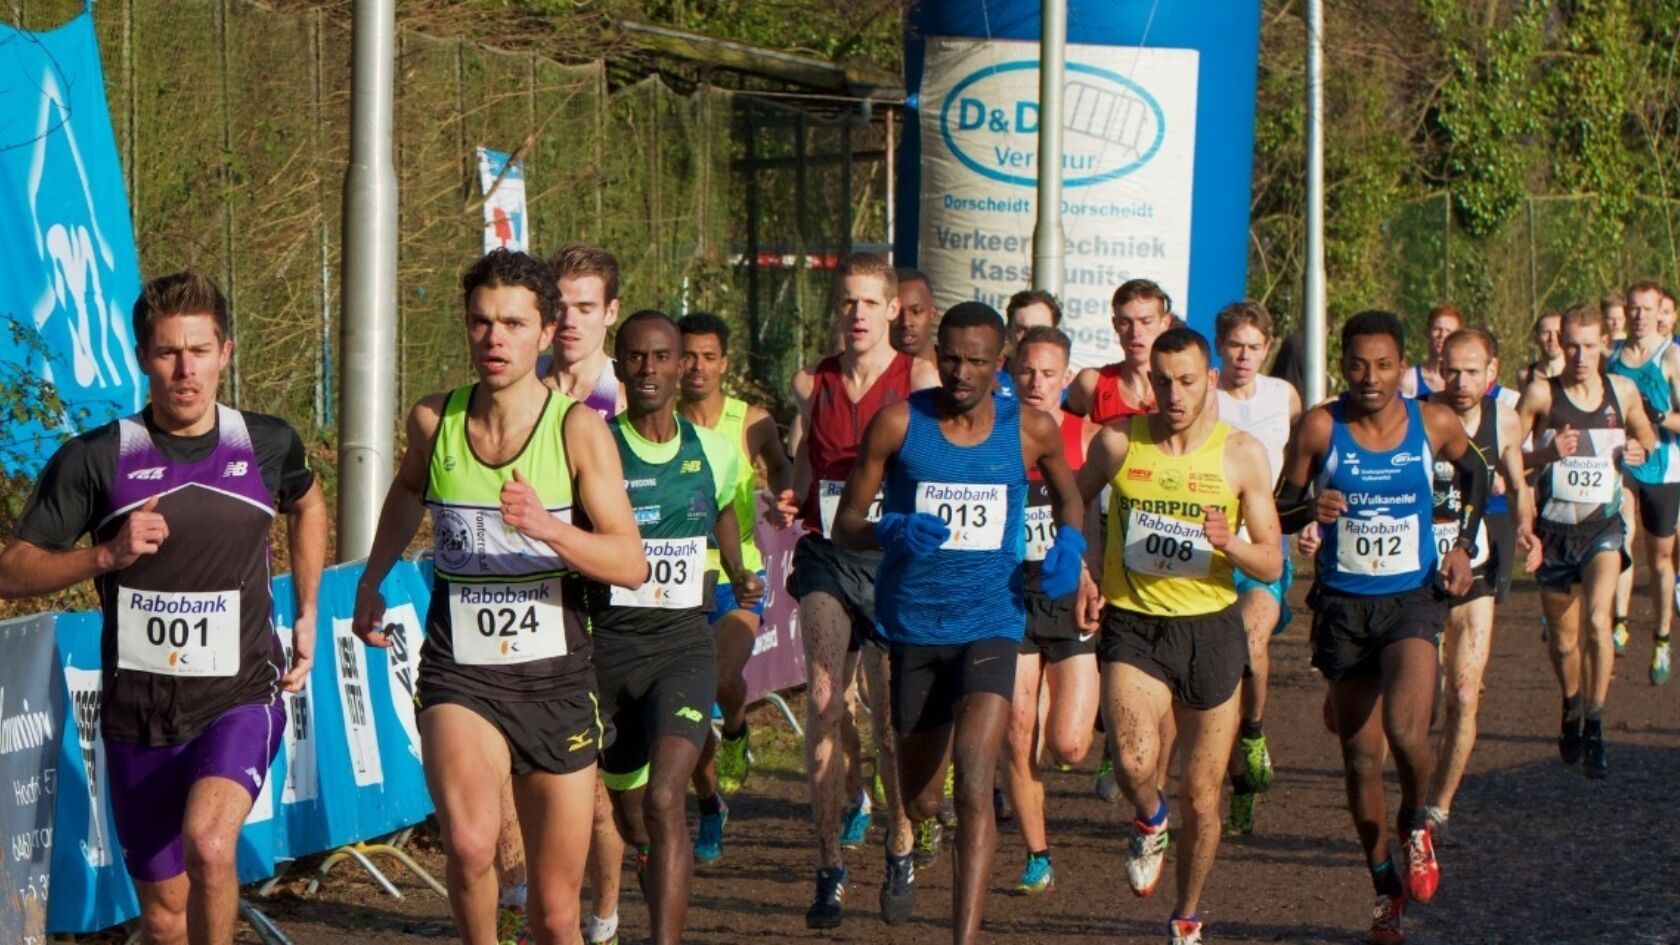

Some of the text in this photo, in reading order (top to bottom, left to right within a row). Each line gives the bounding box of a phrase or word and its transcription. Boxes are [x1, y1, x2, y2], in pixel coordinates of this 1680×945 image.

[944, 194, 1030, 213] Dorscheidt
[1568, 470, 1602, 487] 032
[925, 485, 998, 501] Rabobank
[937, 503, 987, 528] 013
[1346, 520, 1410, 535] Rabobank
[645, 540, 697, 556] bobank
[1146, 533, 1193, 562] 008
[1356, 536, 1401, 557] 012
[130, 593, 226, 613] Rabobank
[460, 584, 549, 604] Rabobank
[477, 606, 539, 637] 024
[147, 617, 208, 647] 001
